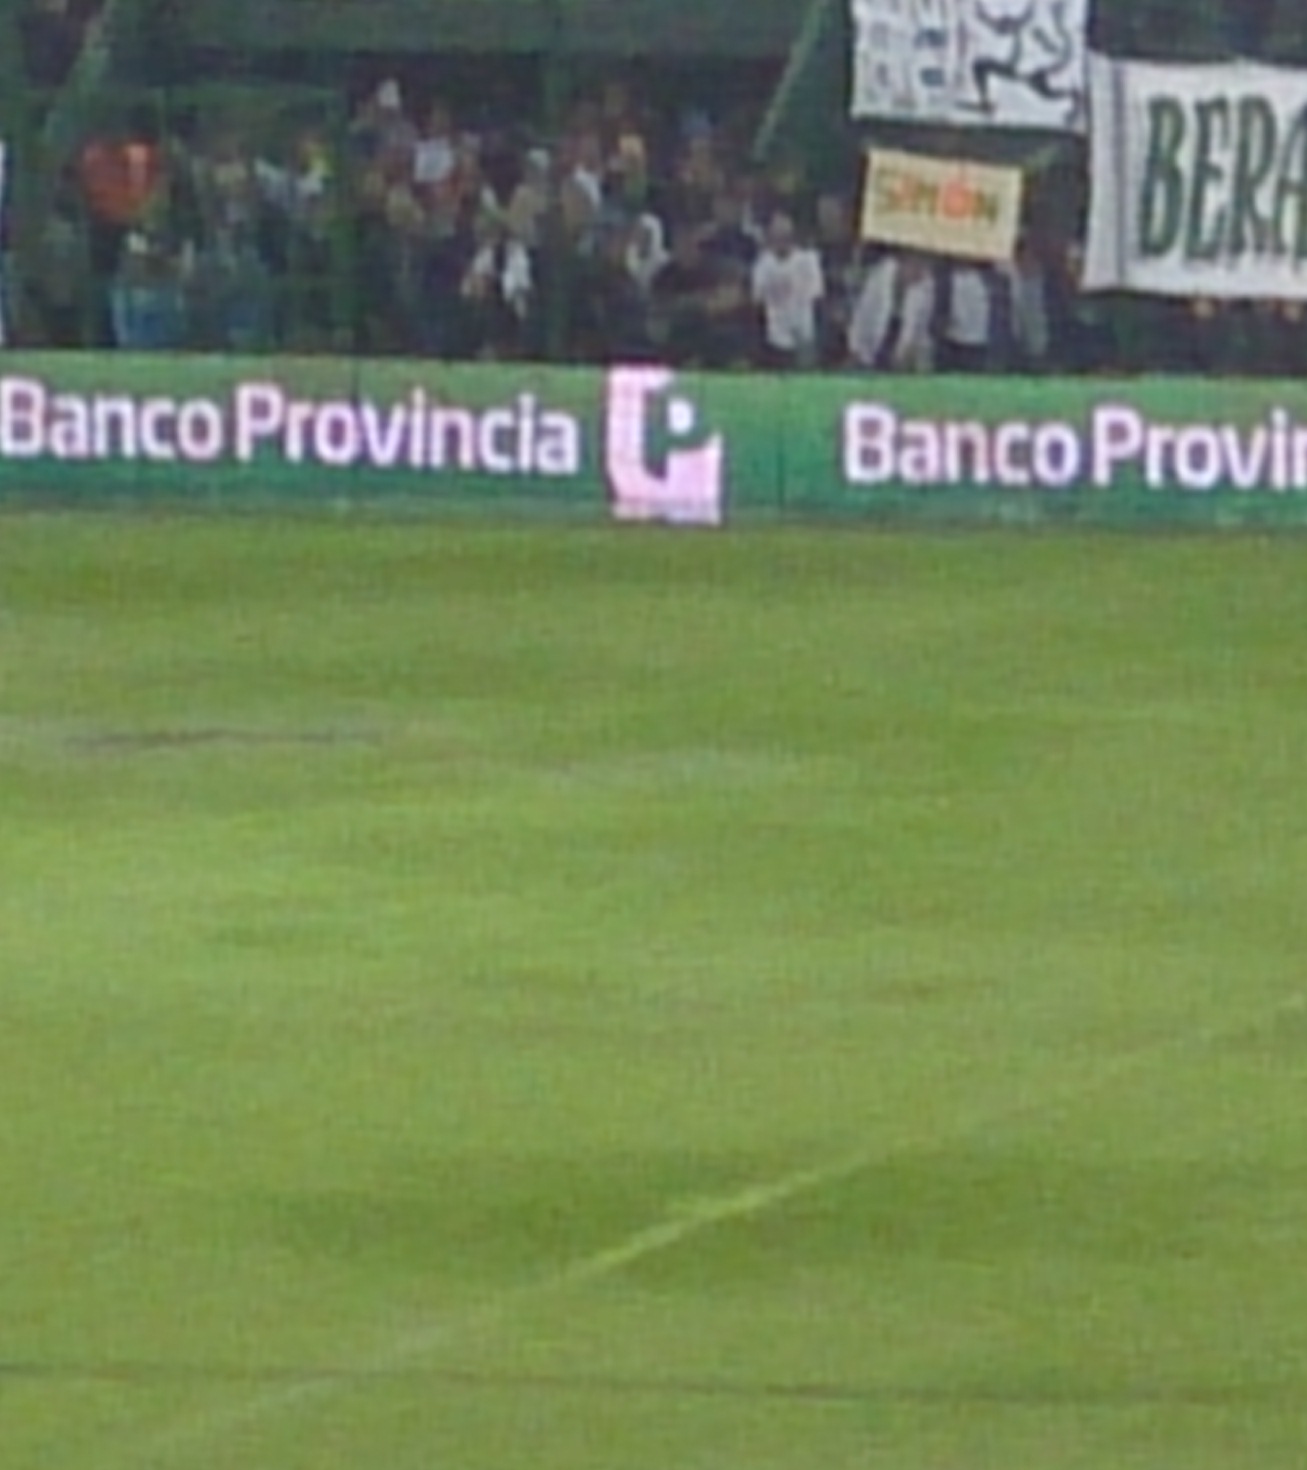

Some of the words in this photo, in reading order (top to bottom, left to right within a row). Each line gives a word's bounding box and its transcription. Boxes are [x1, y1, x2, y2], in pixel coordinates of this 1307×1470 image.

[0, 377, 223, 462] Banco
[234, 382, 579, 475] Provincia
[843, 402, 1080, 487] Banco
